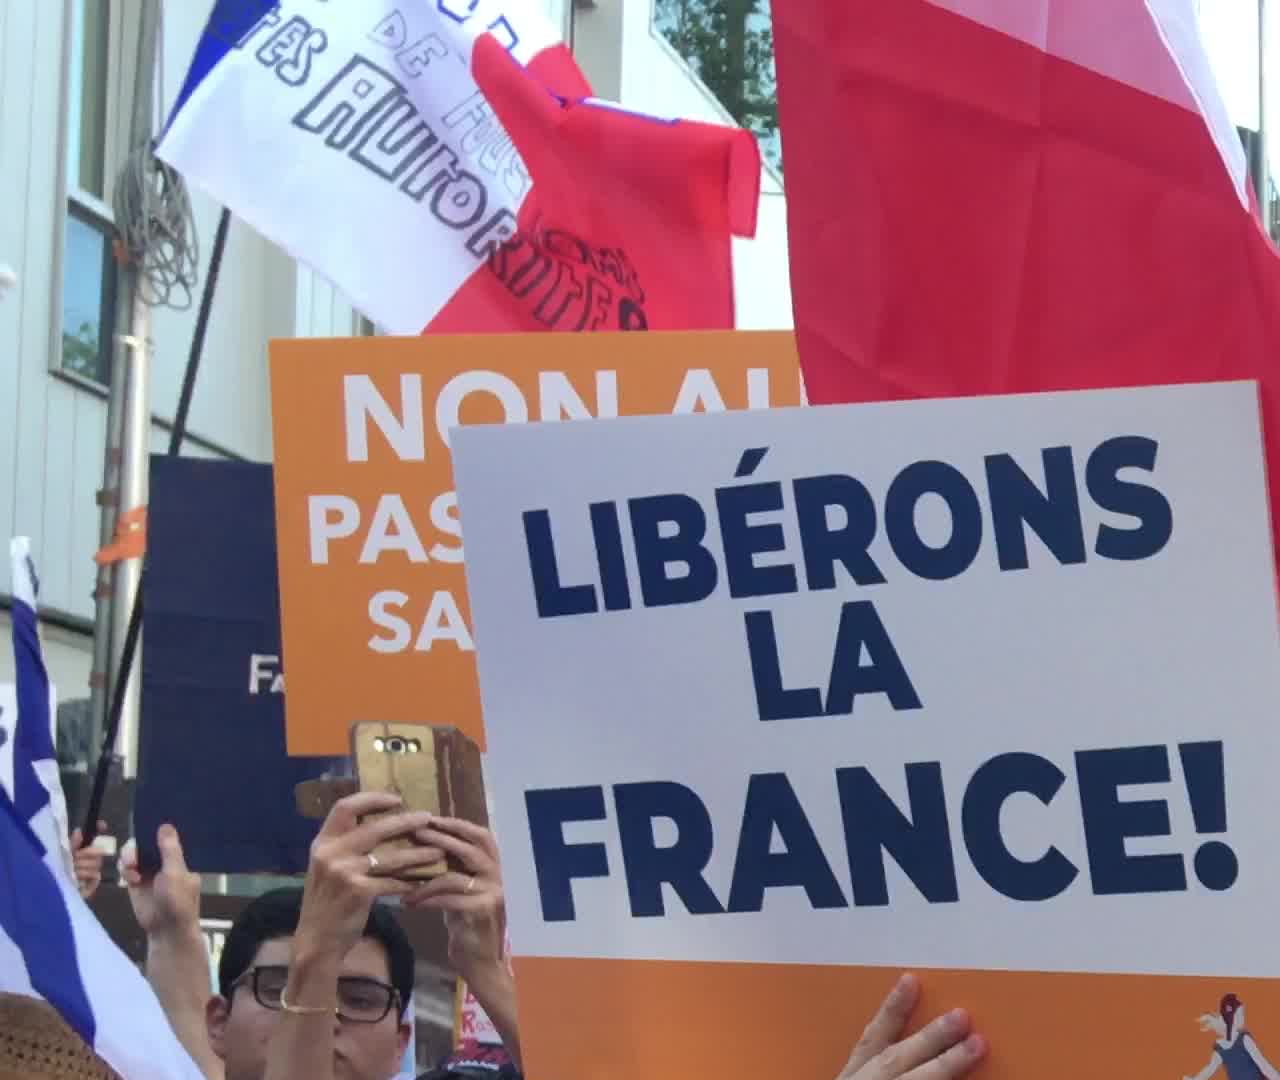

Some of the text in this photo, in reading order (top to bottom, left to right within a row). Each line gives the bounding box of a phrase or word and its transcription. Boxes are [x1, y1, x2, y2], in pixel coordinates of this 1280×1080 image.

[344, 369, 619, 462] NON
[308, 493, 466, 564] PAS
[522, 436, 1173, 619] LIBÉRONS
[368, 590, 476, 654] SA
[744, 601, 923, 721] LA
[524, 741, 1239, 922] FRANCE!
